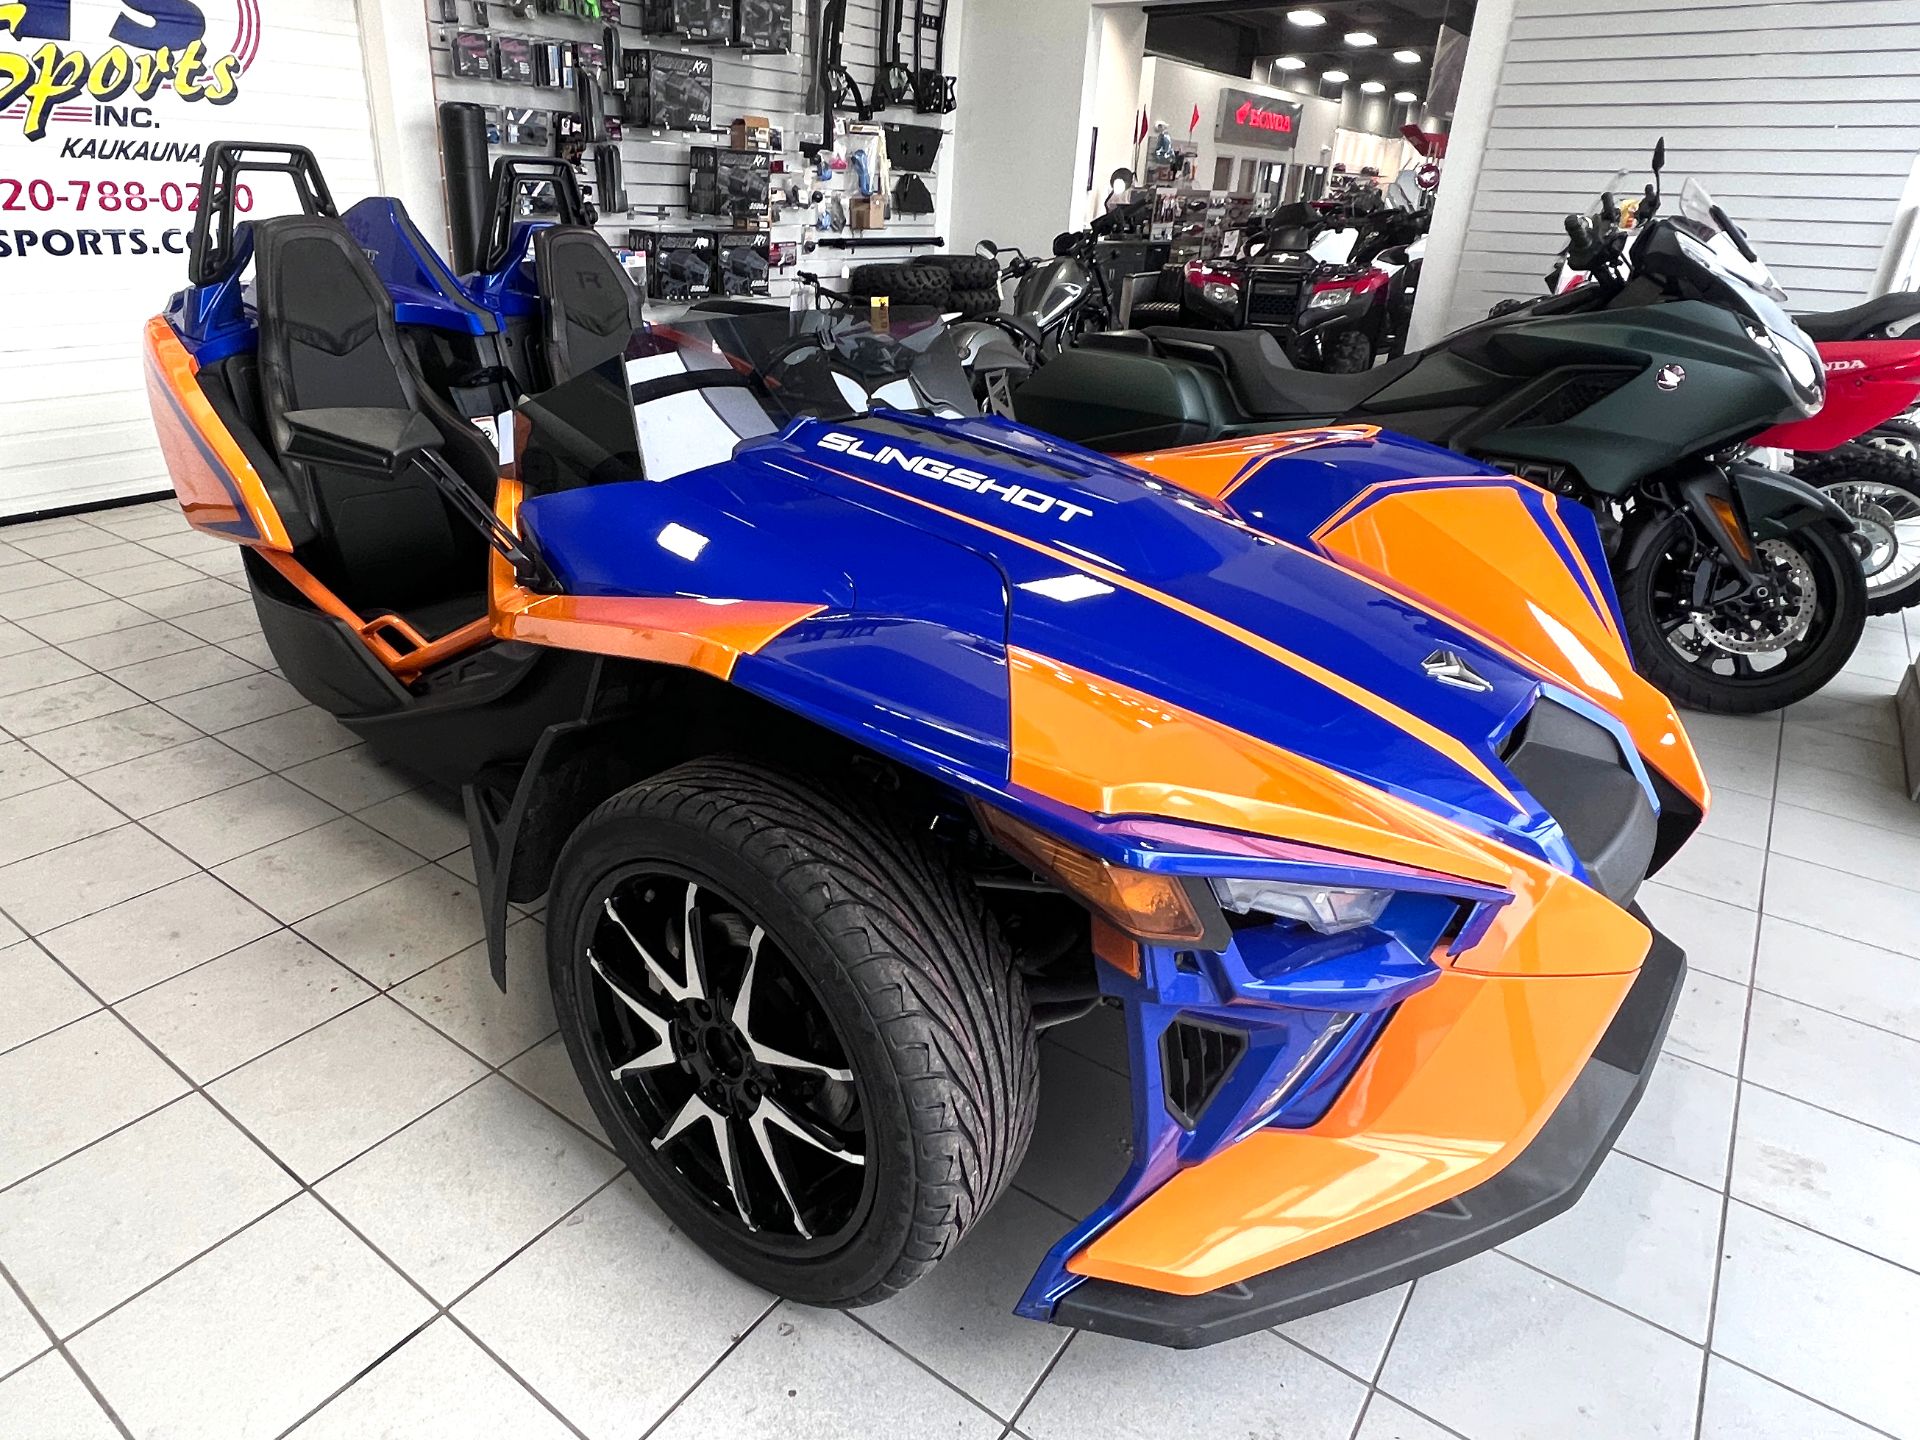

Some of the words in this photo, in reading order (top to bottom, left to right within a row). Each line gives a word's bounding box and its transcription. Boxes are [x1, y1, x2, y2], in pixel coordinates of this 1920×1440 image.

[95, 104, 160, 129] INC.
[1249, 108, 1291, 132] HONDA
[0, 178, 254, 213] 20-788-020
[817, 432, 1093, 522] SLINGSHOT
